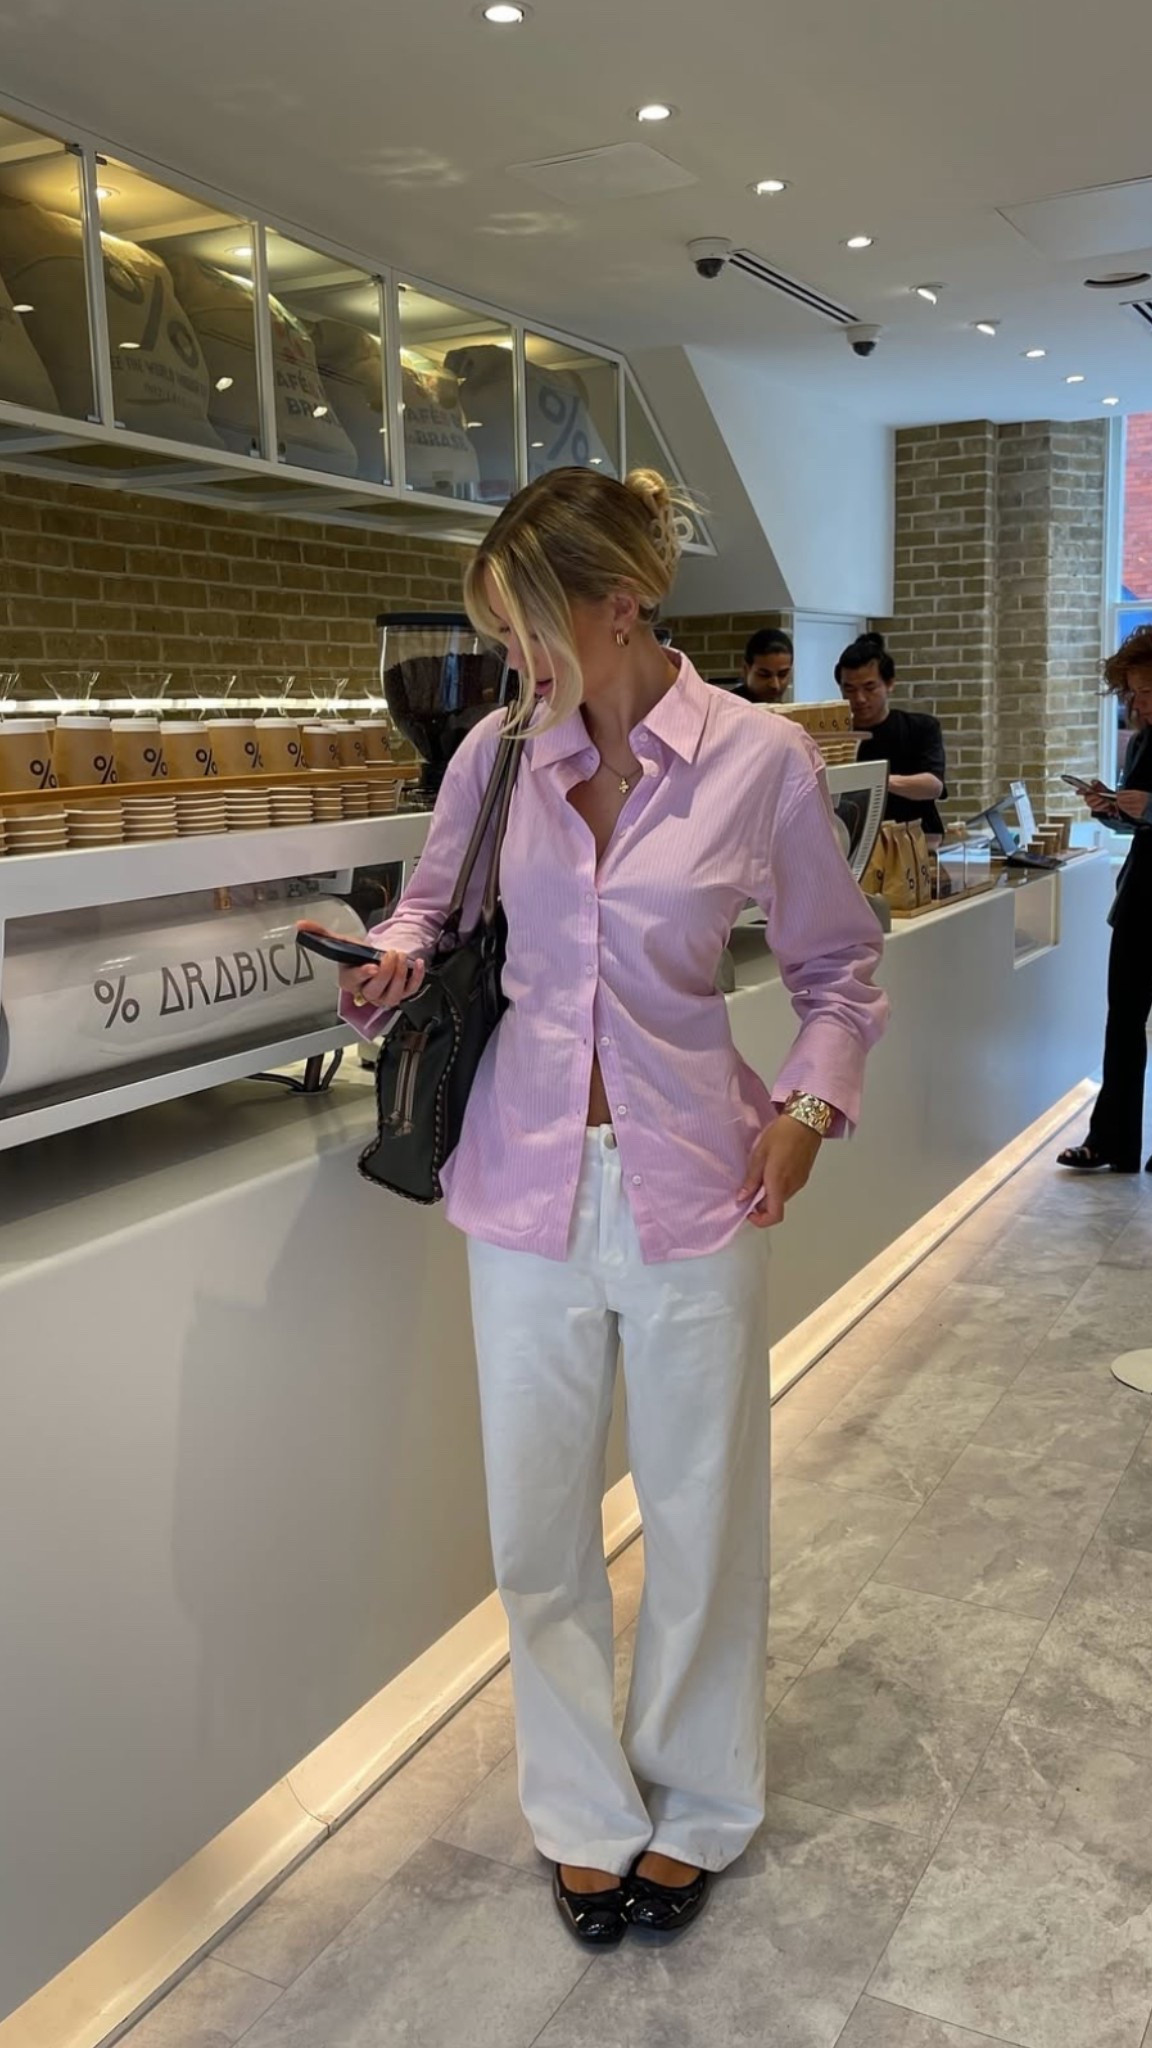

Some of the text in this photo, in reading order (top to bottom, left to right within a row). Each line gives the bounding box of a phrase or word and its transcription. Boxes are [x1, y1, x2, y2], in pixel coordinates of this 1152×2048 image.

[538, 386, 589, 465] %
[29, 758, 57, 789] %
[93, 755, 118, 784] %
[143, 748, 168, 776] %
[195, 748, 218, 776] %
[94, 943, 315, 1029] % ARABICA
